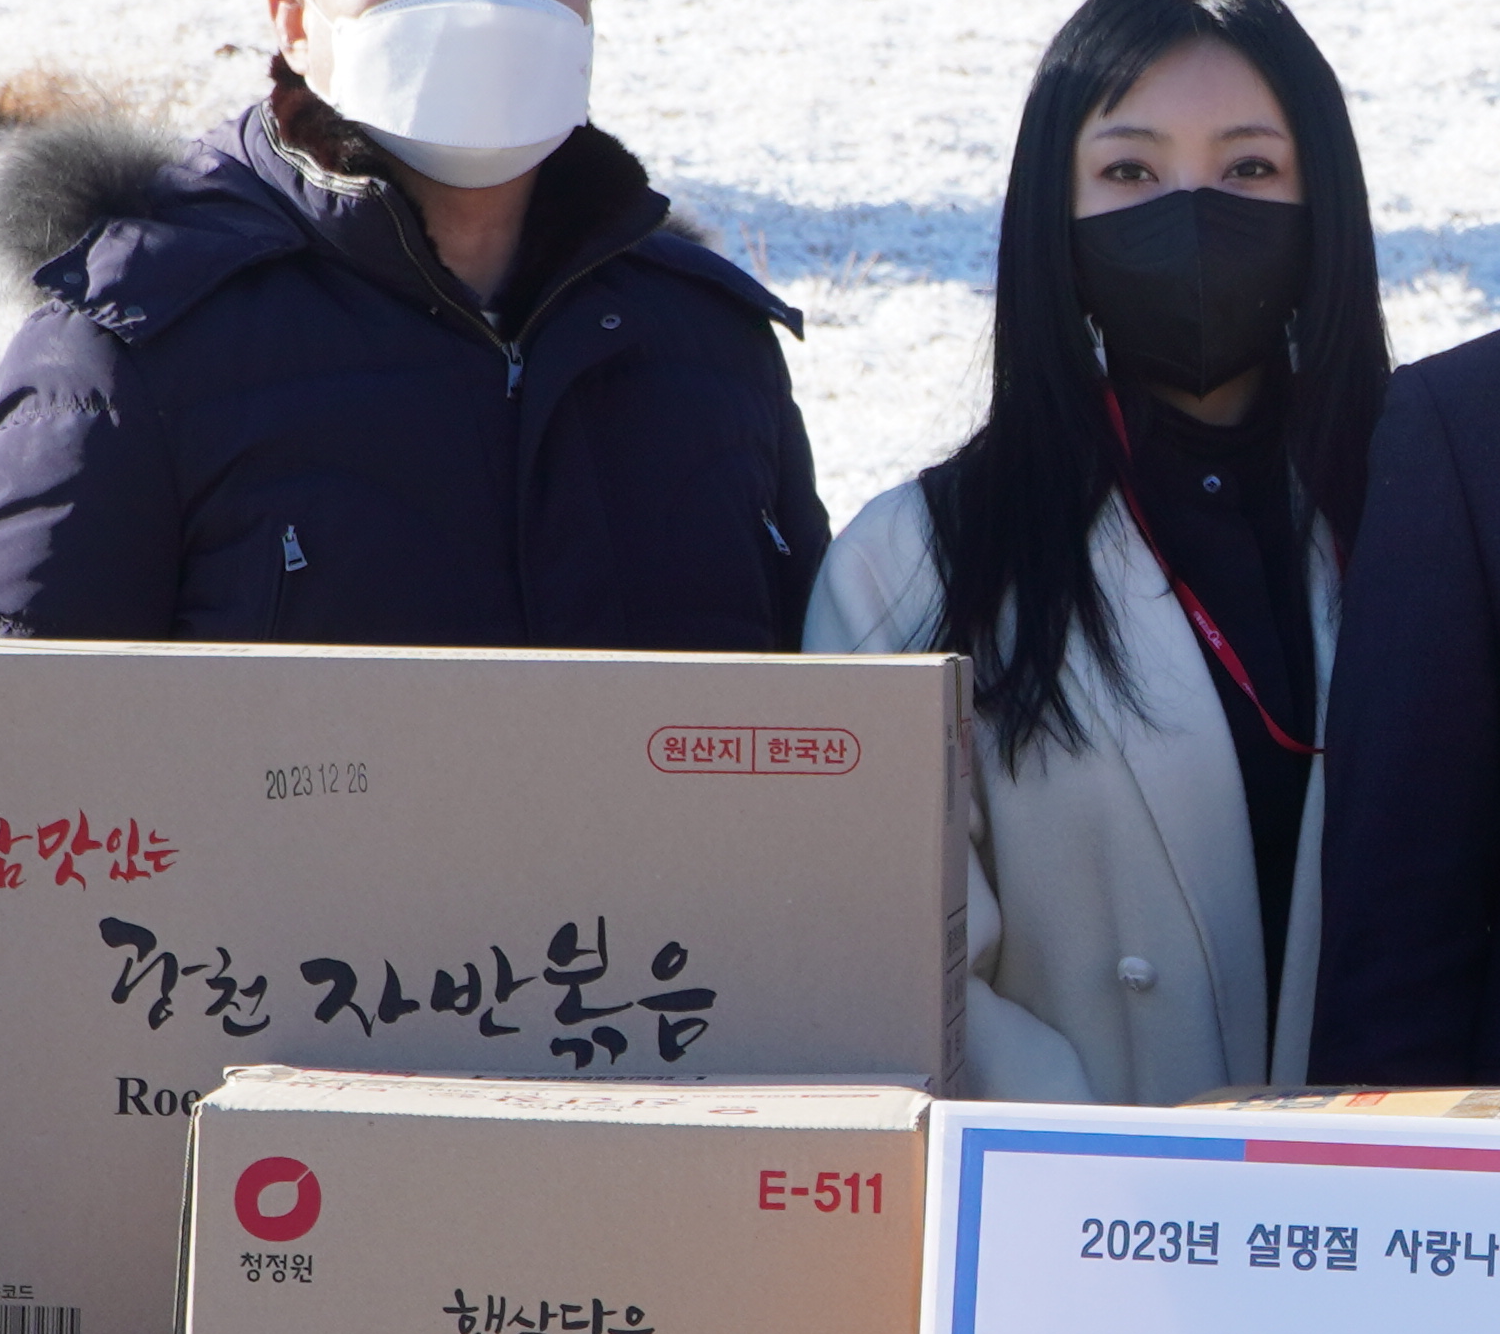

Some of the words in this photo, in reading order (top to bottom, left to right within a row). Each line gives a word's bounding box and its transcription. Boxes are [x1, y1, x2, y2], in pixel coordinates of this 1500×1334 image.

[663, 737, 742, 763] 원산지
[768, 737, 847, 764] 한국산
[300, 916, 717, 1070] 자반볶음
[759, 1169, 885, 1214] E-511
[239, 1251, 314, 1284] 청정원
[1080, 1219, 1220, 1266] 2023년
[1246, 1223, 1359, 1272] 설명절
